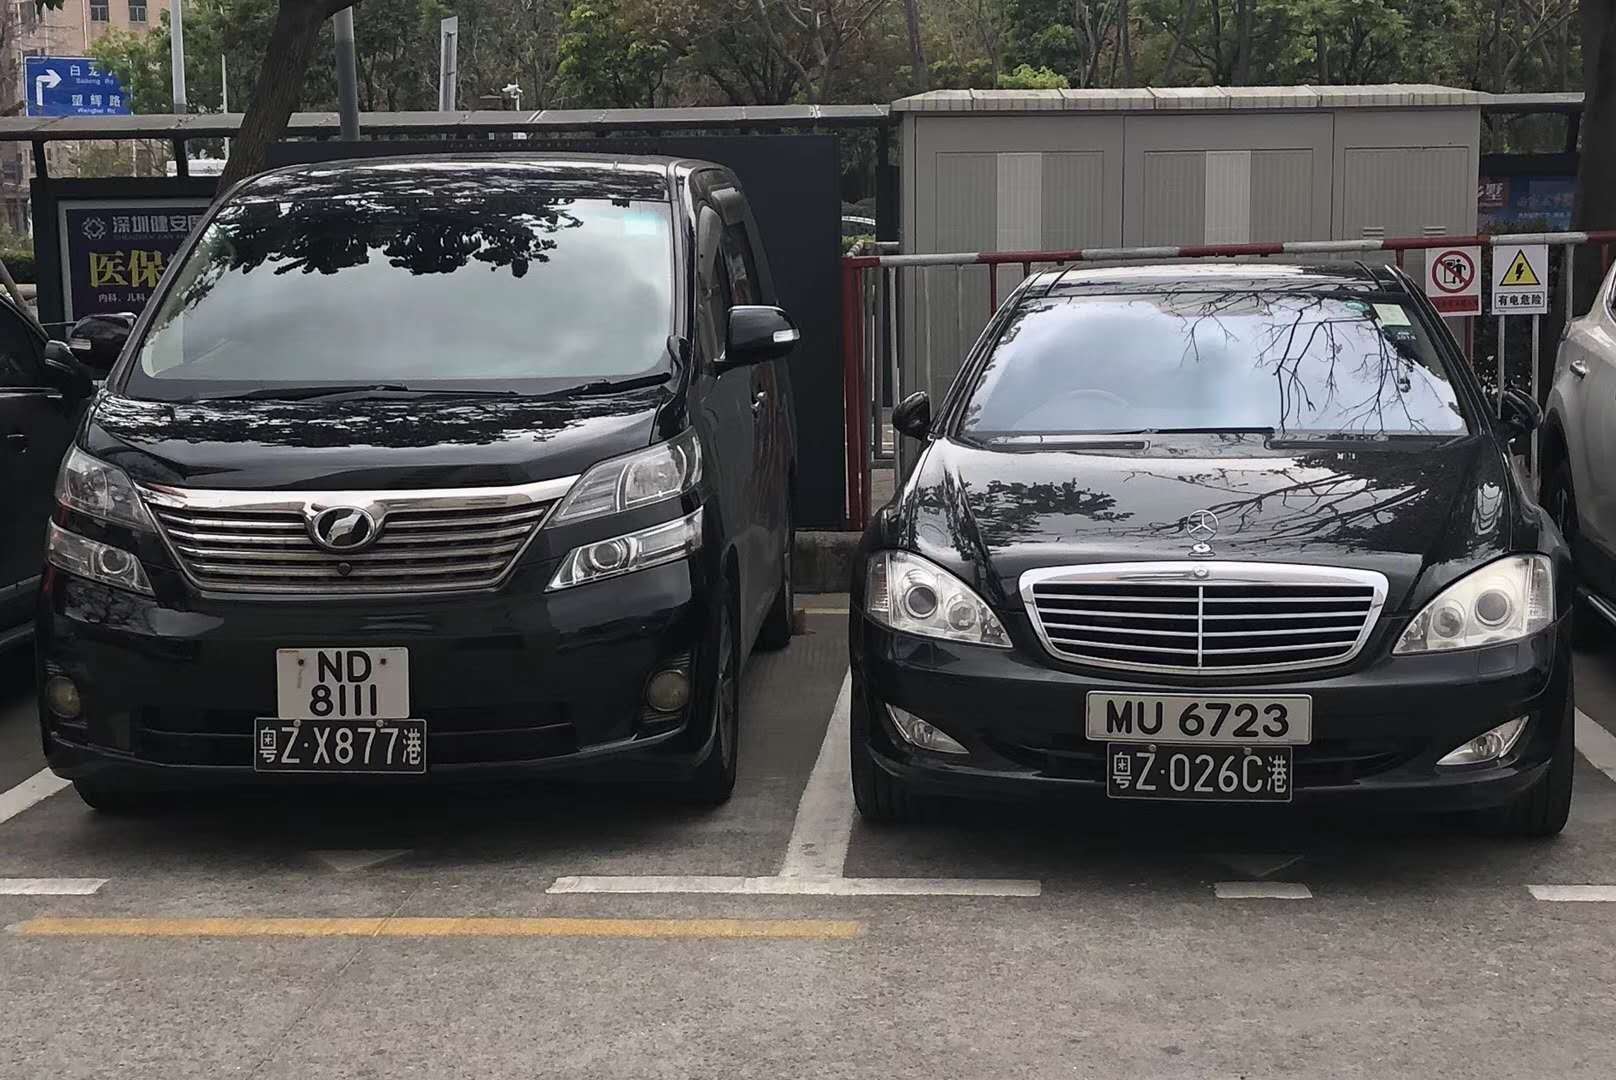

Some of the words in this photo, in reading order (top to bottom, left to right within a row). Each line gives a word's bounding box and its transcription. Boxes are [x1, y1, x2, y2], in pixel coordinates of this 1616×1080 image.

[1499, 294, 1542, 306] 有电危险
[317, 650, 371, 683] ND
[309, 684, 377, 716] 8111
[1106, 699, 1163, 735] MU
[1178, 702, 1289, 738] 6723
